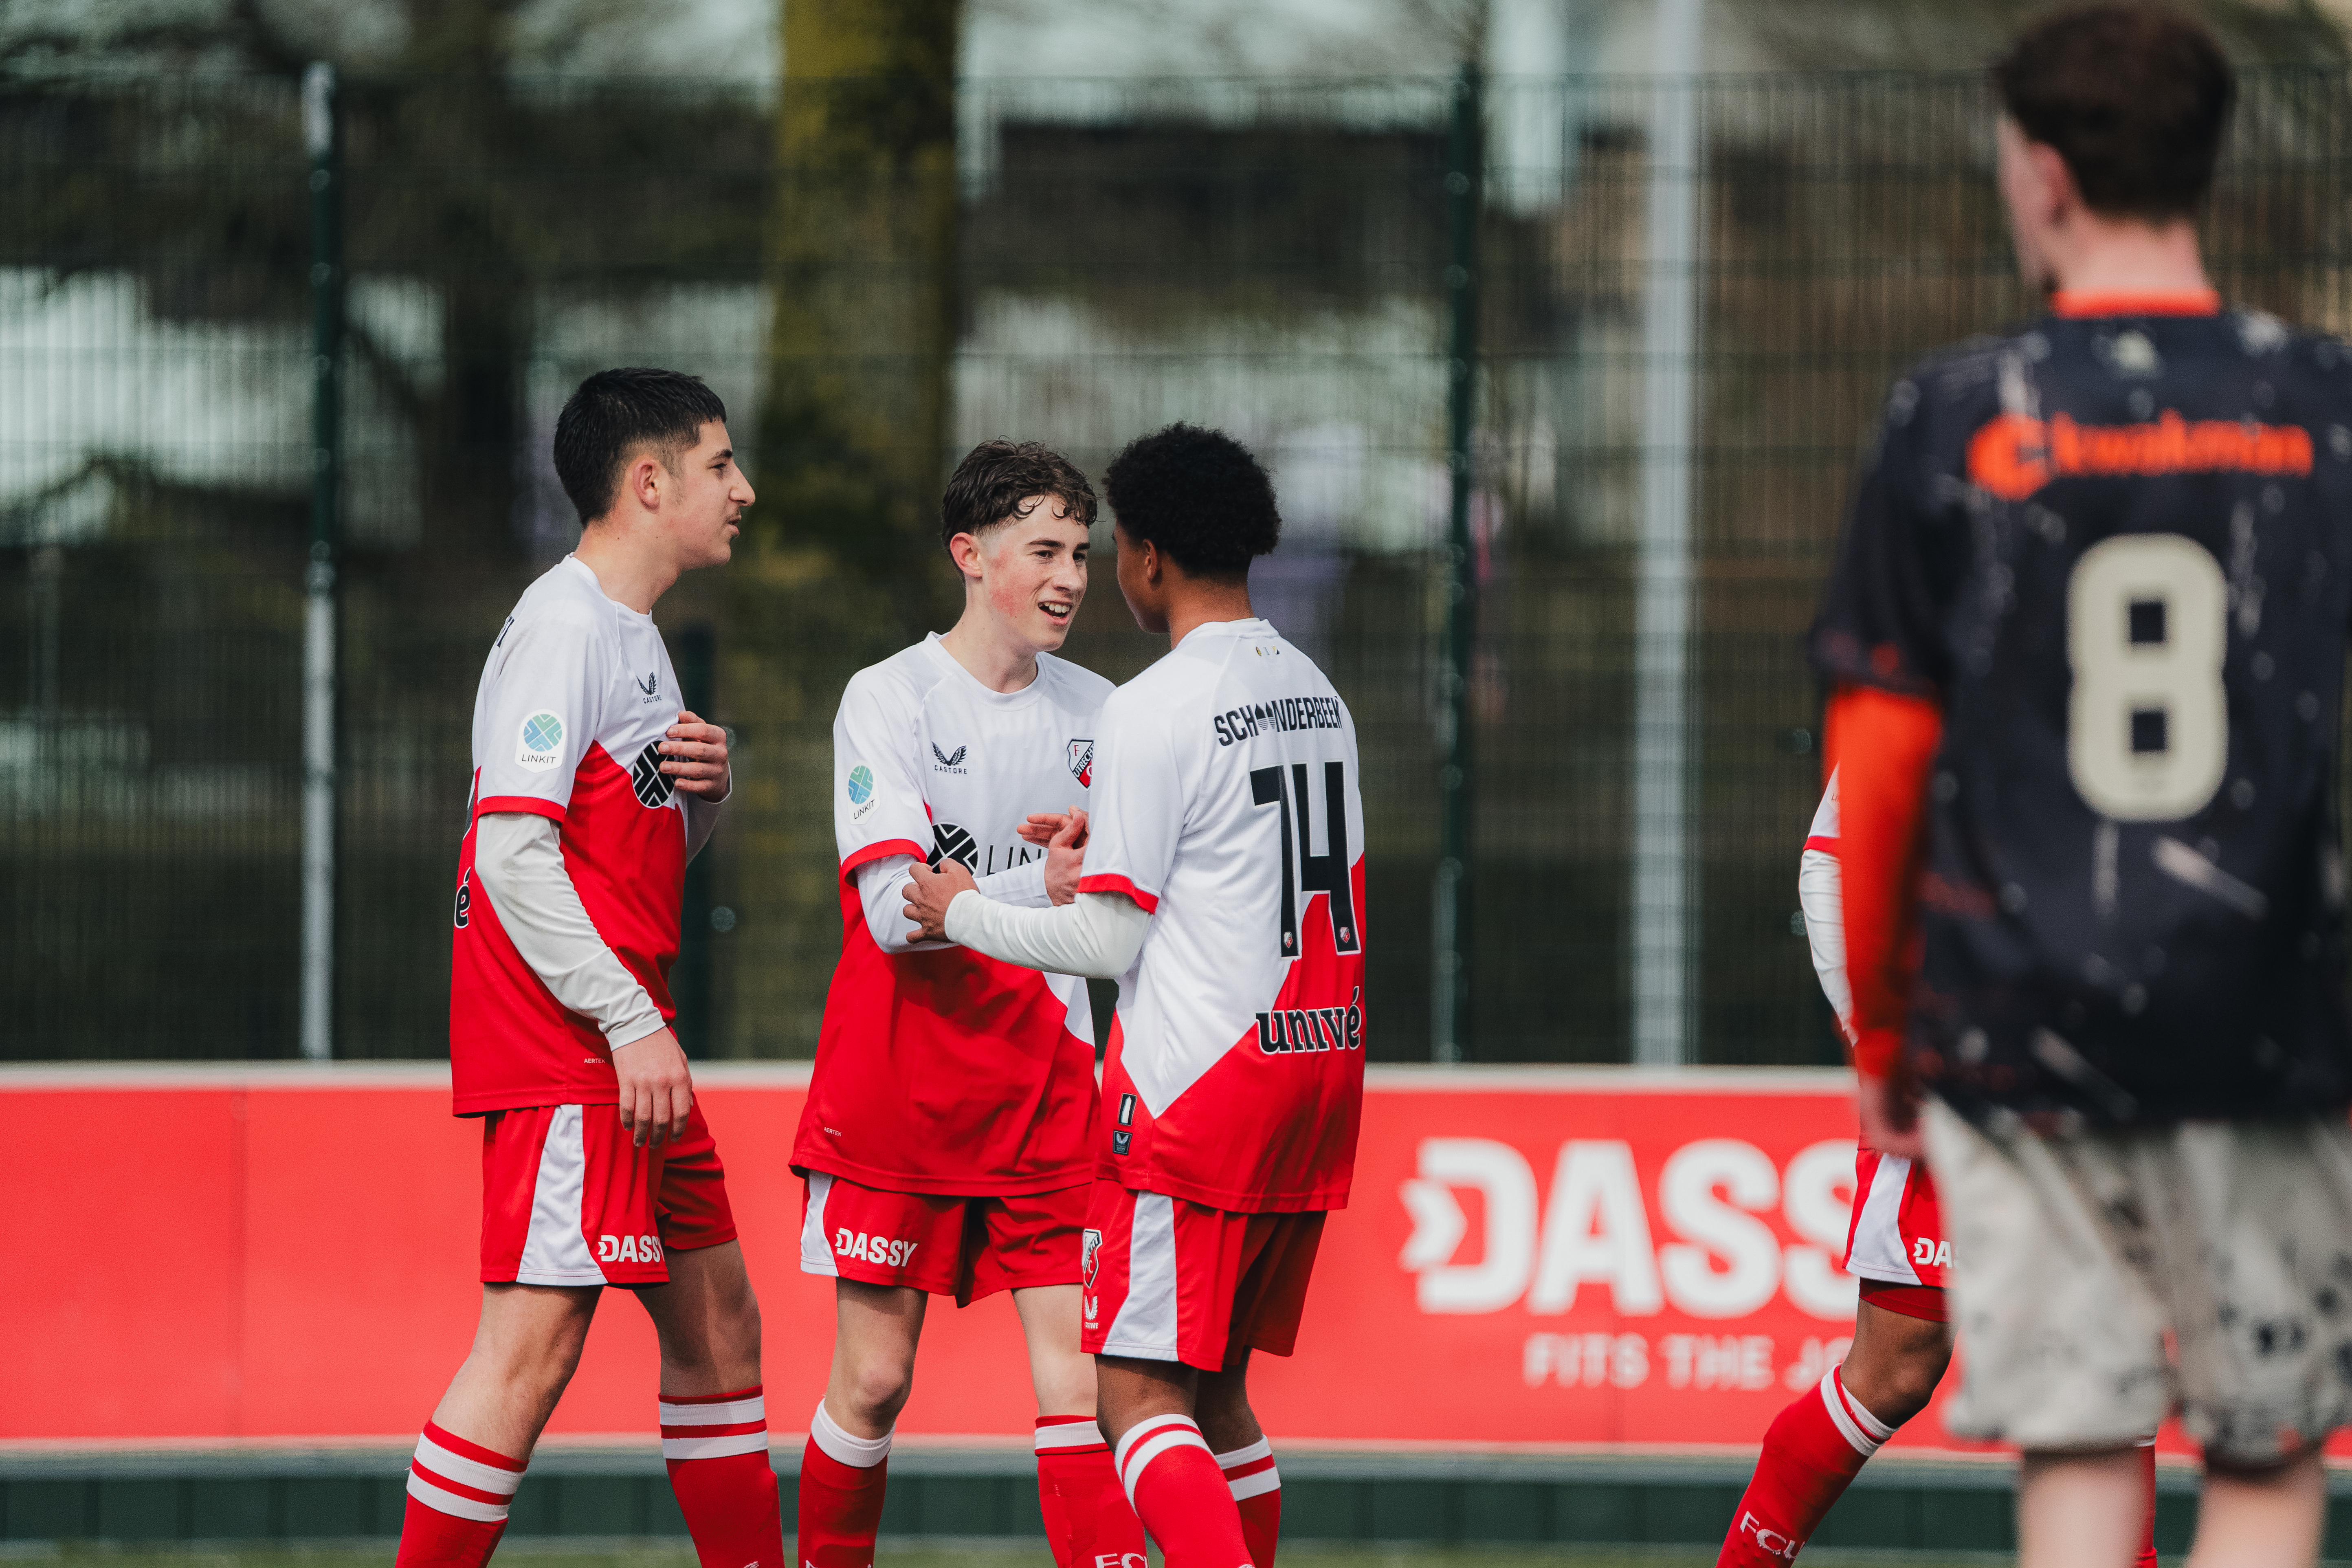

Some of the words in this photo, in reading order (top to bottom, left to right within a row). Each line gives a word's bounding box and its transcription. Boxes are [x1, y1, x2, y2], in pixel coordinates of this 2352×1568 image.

[2066, 533, 2228, 822] 8
[643, 695, 662, 704] CASTORE
[522, 754, 556, 764] LINKIT
[934, 765, 967, 774] CASTORE
[1073, 743, 1093, 778] UTRECH
[854, 799, 875, 820] LINKIT
[987, 844, 1042, 876] LIN
[1250, 761, 1361, 958] 14
[1255, 986, 1361, 1055] univé
[824, 1127, 842, 1137] AERTEK
[1399, 1138, 1859, 1320] DASS
[835, 1227, 918, 1267] DASSY
[1523, 1333, 1650, 1388] FITS
[1660, 1334, 1775, 1391] THE
